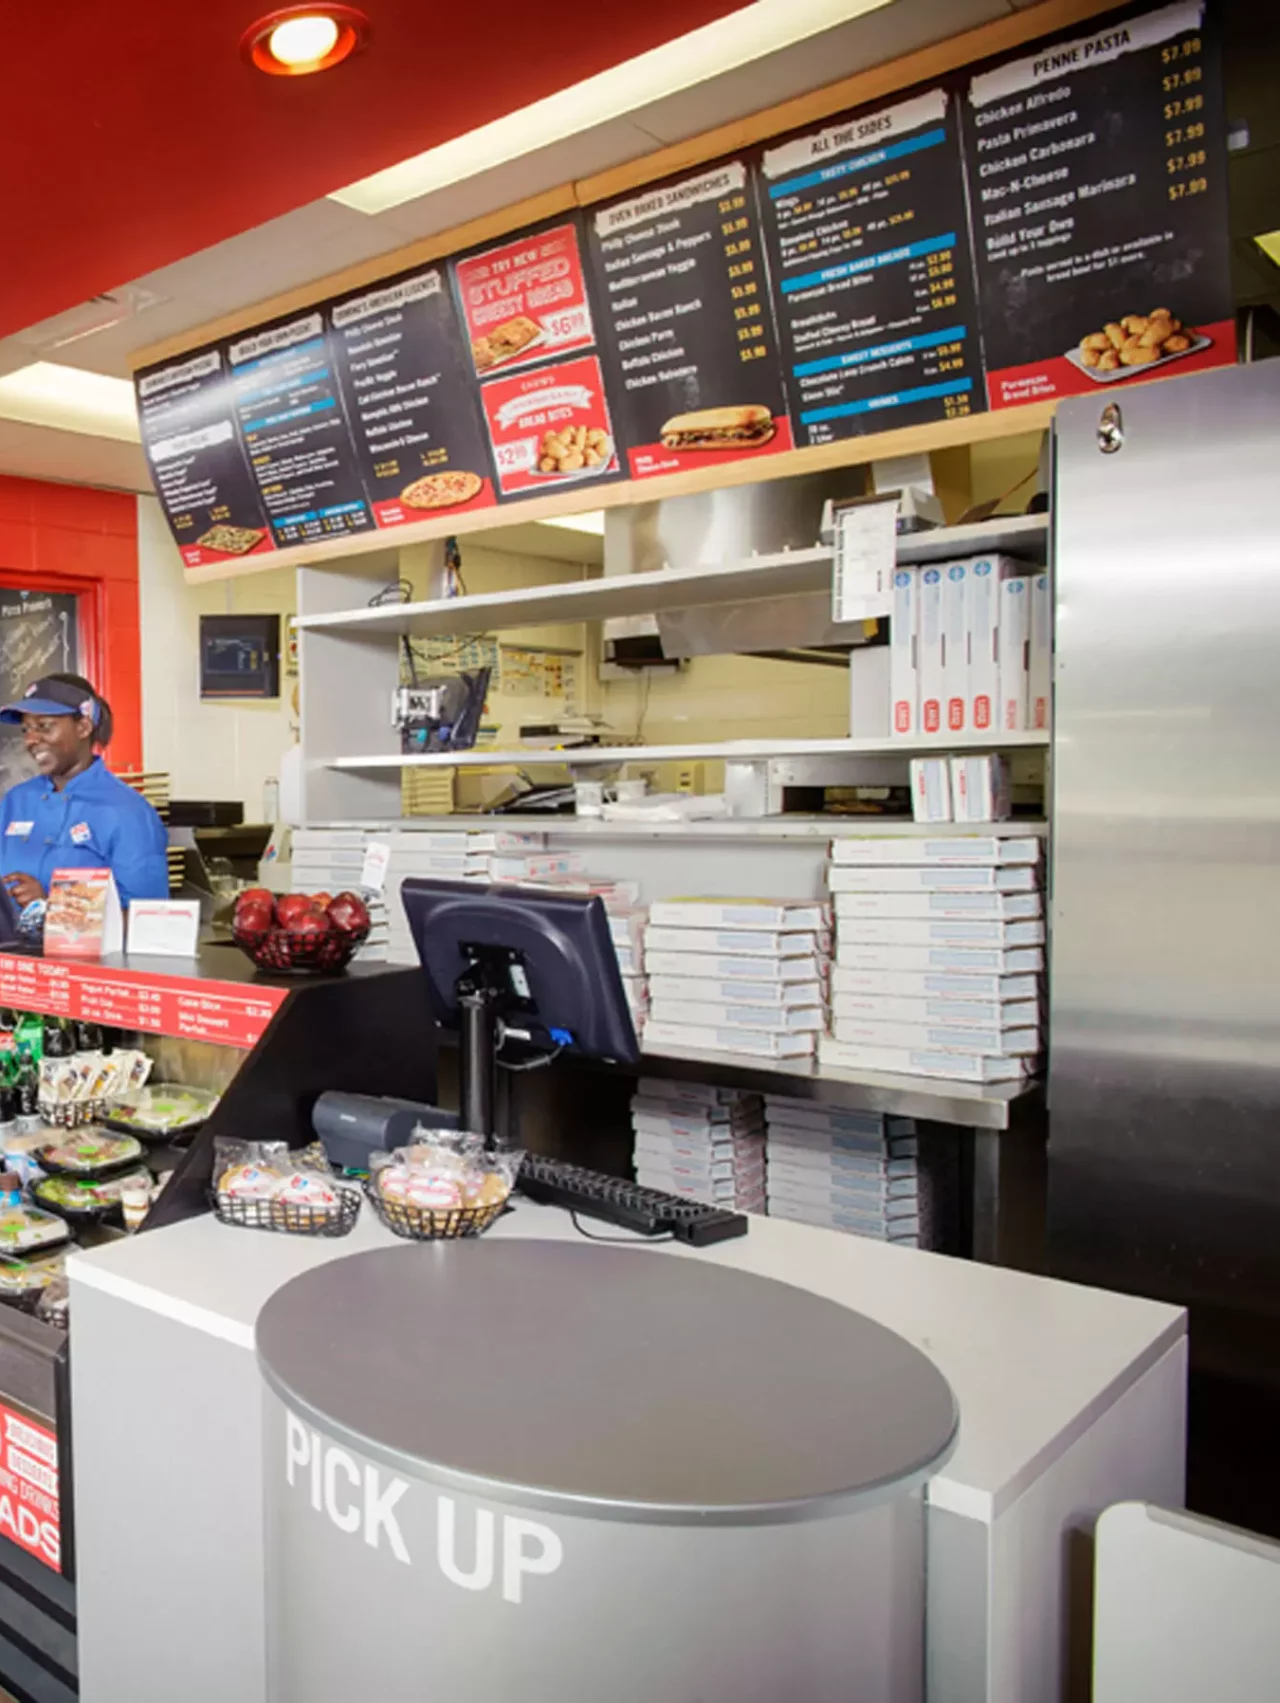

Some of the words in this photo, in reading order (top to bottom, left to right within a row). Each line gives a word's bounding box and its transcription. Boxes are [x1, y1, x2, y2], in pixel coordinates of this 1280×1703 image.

[1033, 50, 1081, 77] PENNE
[1084, 29, 1131, 59] PASTA
[975, 101, 1023, 127] Chicken
[1026, 86, 1071, 110] Alfredo
[811, 139, 830, 155] ALL
[833, 129, 855, 147] THE
[858, 115, 892, 139] SIDES
[977, 133, 1011, 152] Pasta
[1013, 110, 1078, 140] Primavera
[979, 153, 1028, 178] Chicken
[1029, 131, 1096, 161] Carbonara
[609, 207, 632, 226] OVEN
[635, 196, 663, 217] BAKED
[665, 173, 730, 205] SANDWICHES
[981, 167, 1069, 202] Mac-N-Cheese
[984, 206, 1022, 227] Italian
[1024, 191, 1076, 216] Sausage
[1078, 173, 1136, 199] Marinara
[675, 231, 712, 251] Peppers
[986, 231, 1017, 251] Build
[1019, 225, 1046, 243] Your
[1049, 217, 1075, 234] Own
[467, 256, 571, 305] STUFFED
[491, 257, 511, 274] TRY
[514, 249, 538, 267] NEW
[1001, 373, 1048, 391] Parmesan
[1002, 386, 1030, 401] Bread
[286, 1410, 412, 1566] PICK
[436, 1495, 563, 1606] UP
